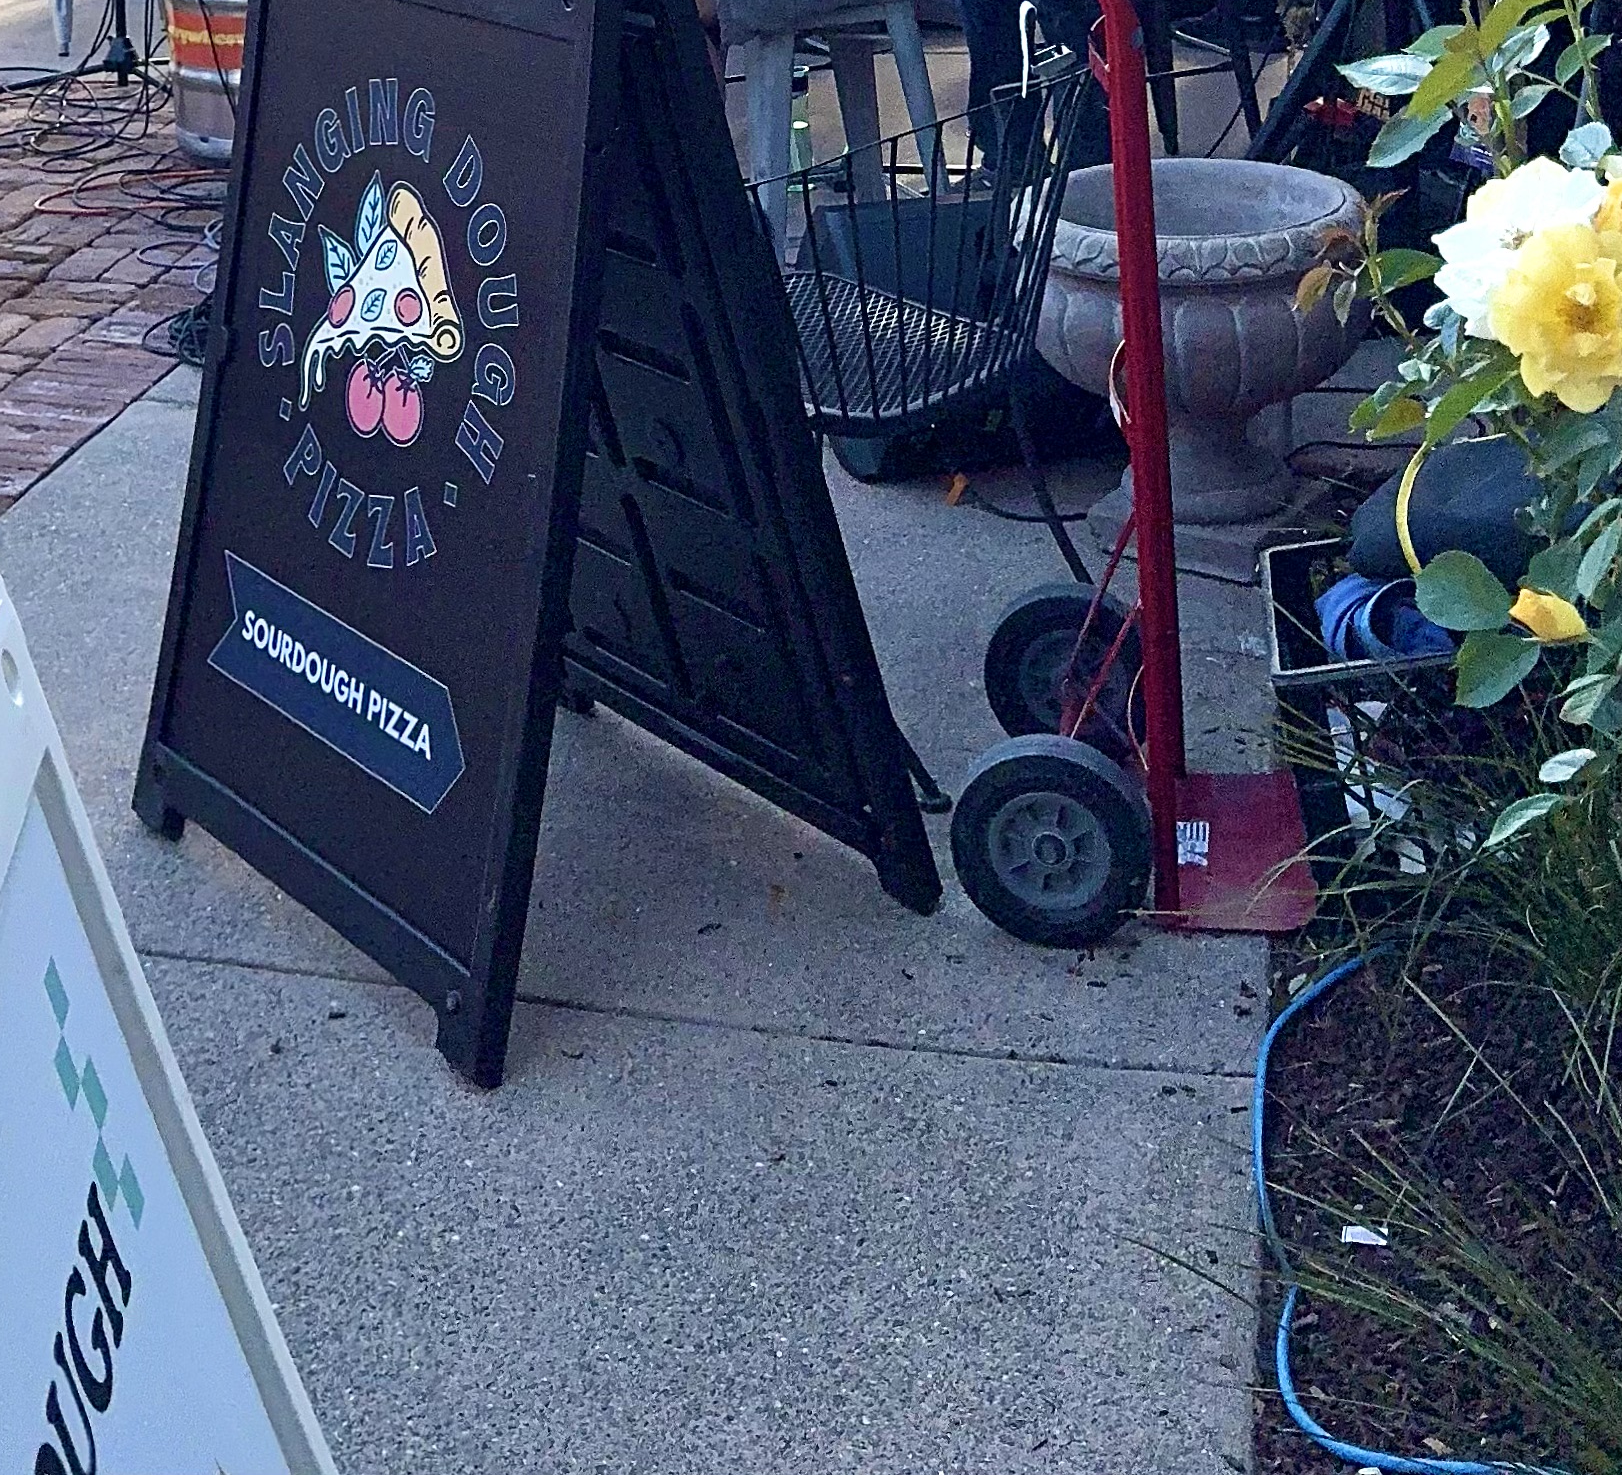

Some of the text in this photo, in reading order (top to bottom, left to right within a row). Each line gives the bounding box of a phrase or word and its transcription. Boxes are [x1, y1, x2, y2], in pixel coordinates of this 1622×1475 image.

[258, 76, 521, 485] SLANGING DOUGH
[283, 422, 438, 570] PIZZA
[241, 609, 432, 762] SOURDOUGH PIZZA
